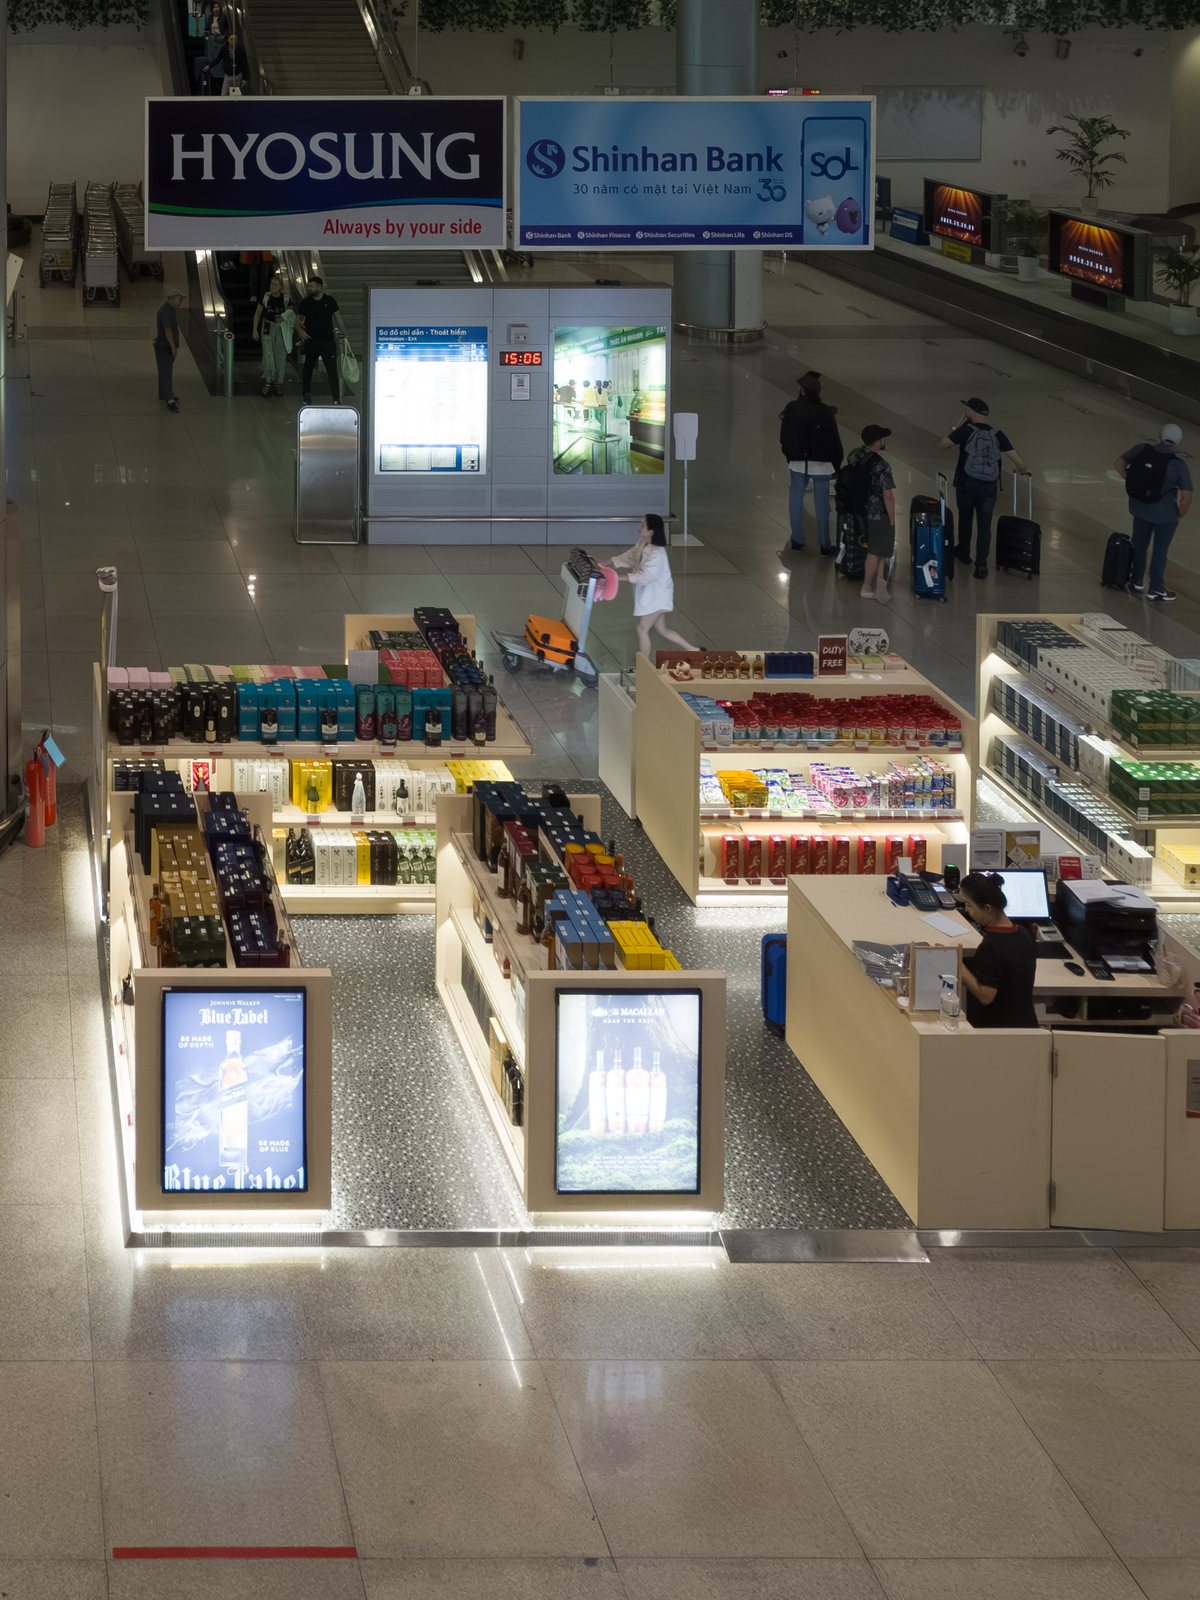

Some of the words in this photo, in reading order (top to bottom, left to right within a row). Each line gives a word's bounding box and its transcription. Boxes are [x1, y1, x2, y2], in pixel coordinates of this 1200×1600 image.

[170, 131, 481, 180] HYOSUNG
[572, 146, 697, 172] Shinhan
[706, 146, 784, 172] Bank
[572, 183, 588, 195] 30
[593, 183, 618, 195] năm
[623, 182, 638, 195] có
[643, 183, 668, 198] mặt
[693, 183, 719, 198] Việt
[724, 184, 752, 195] Nam
[323, 219, 382, 238] Always
[385, 219, 405, 238] by
[409, 223, 446, 238] your
[450, 219, 482, 235] side
[505, 352, 542, 366] 15:06
[822, 646, 844, 655] DUTY
[822, 659, 844, 668] FREE
[199, 1008, 232, 1026] Blue
[232, 1008, 268, 1026] Label
